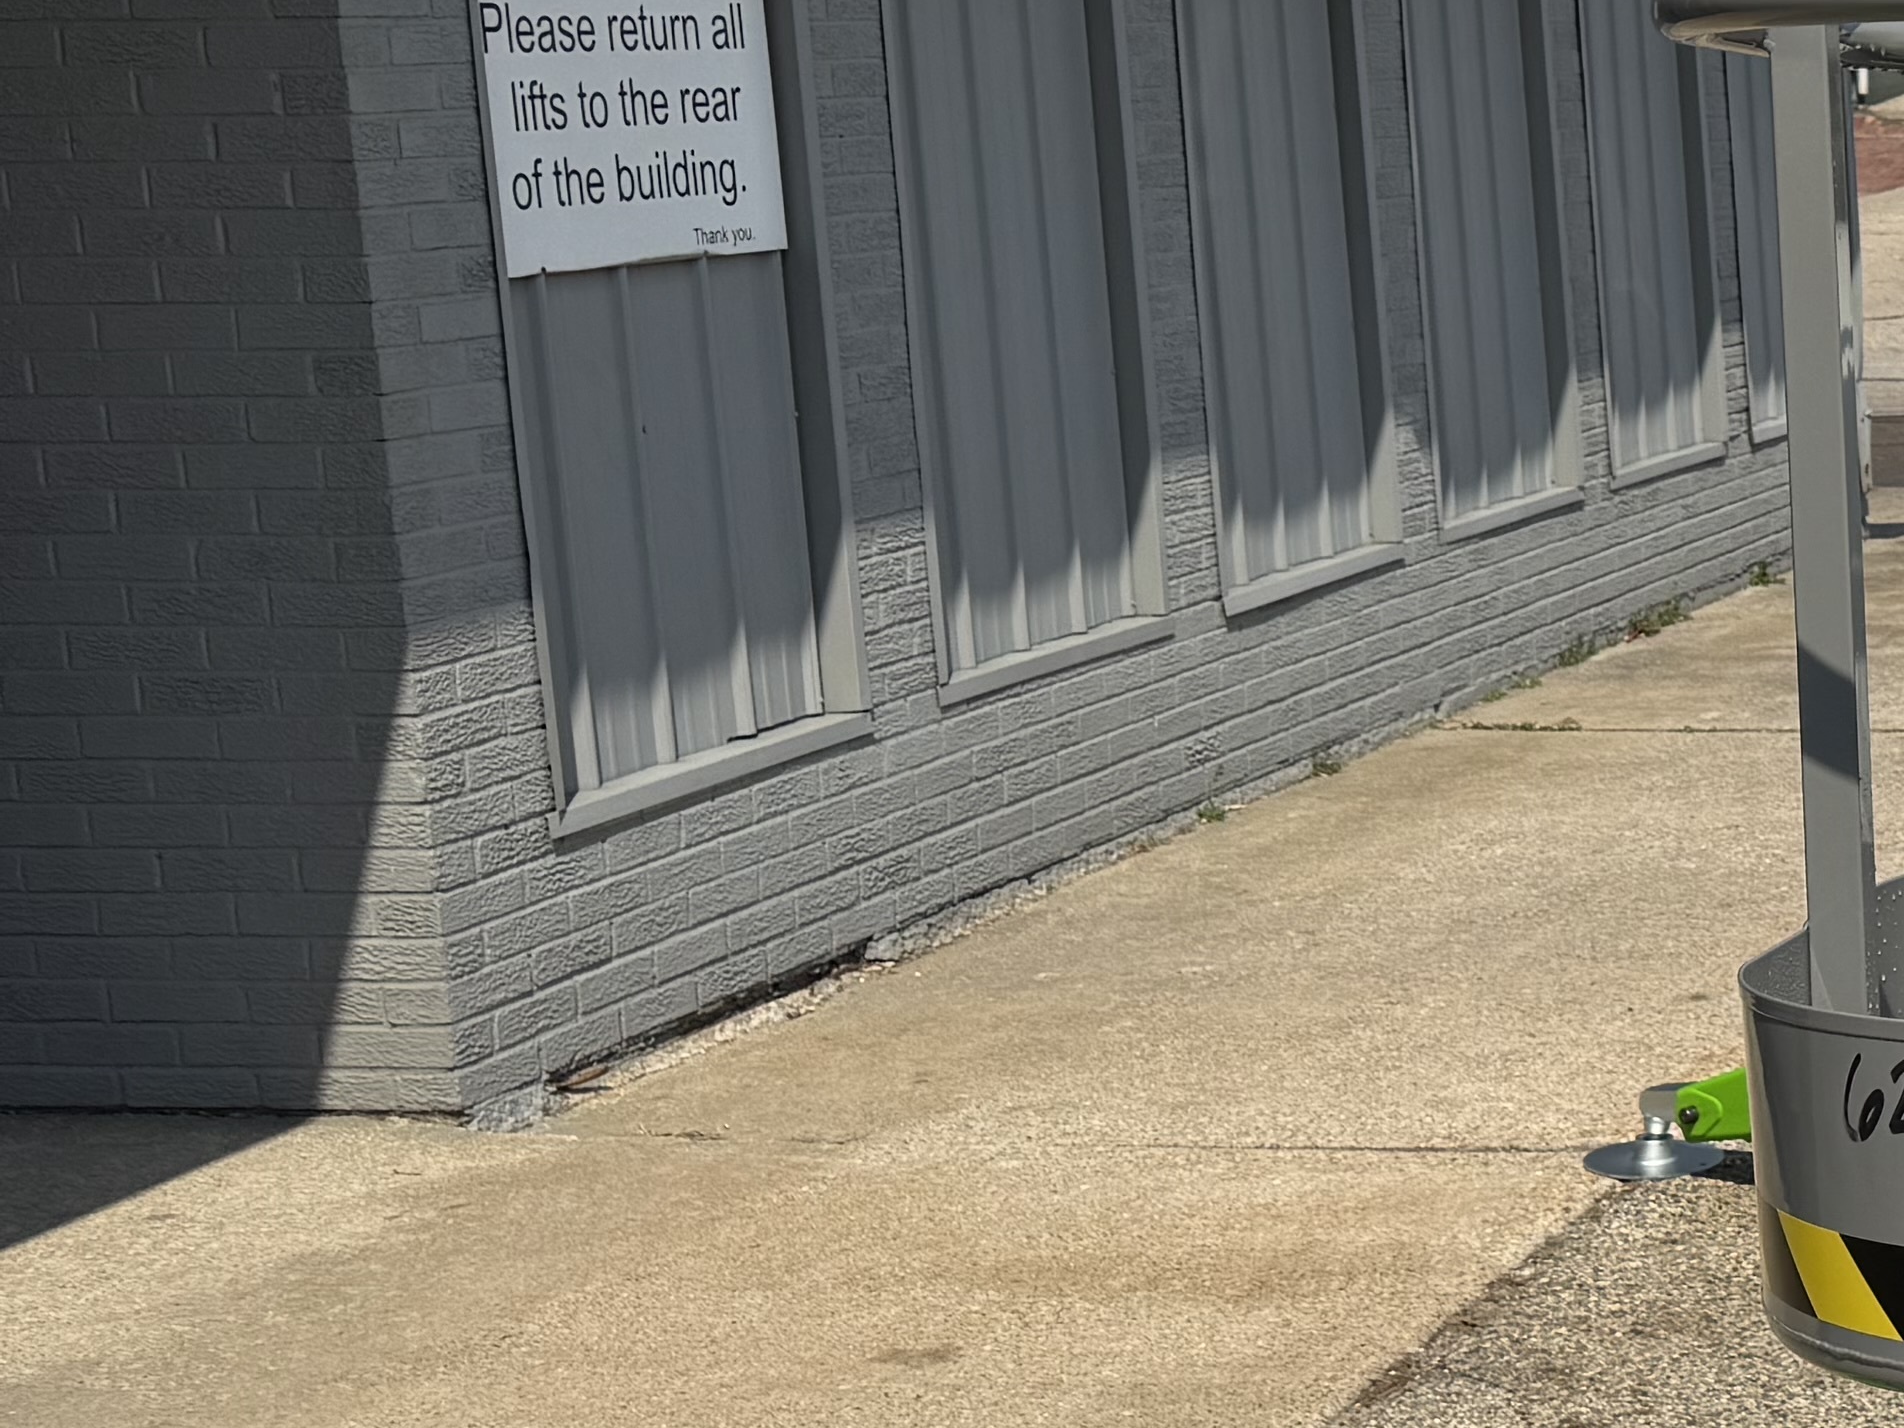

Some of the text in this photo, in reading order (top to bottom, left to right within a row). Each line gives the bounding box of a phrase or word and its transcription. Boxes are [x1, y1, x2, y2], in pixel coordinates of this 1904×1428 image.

[479, 2, 745, 55] Please return all
[511, 77, 741, 132] lifts to the rear
[511, 149, 747, 211] of the building.
[693, 226, 756, 247] Thank you.
